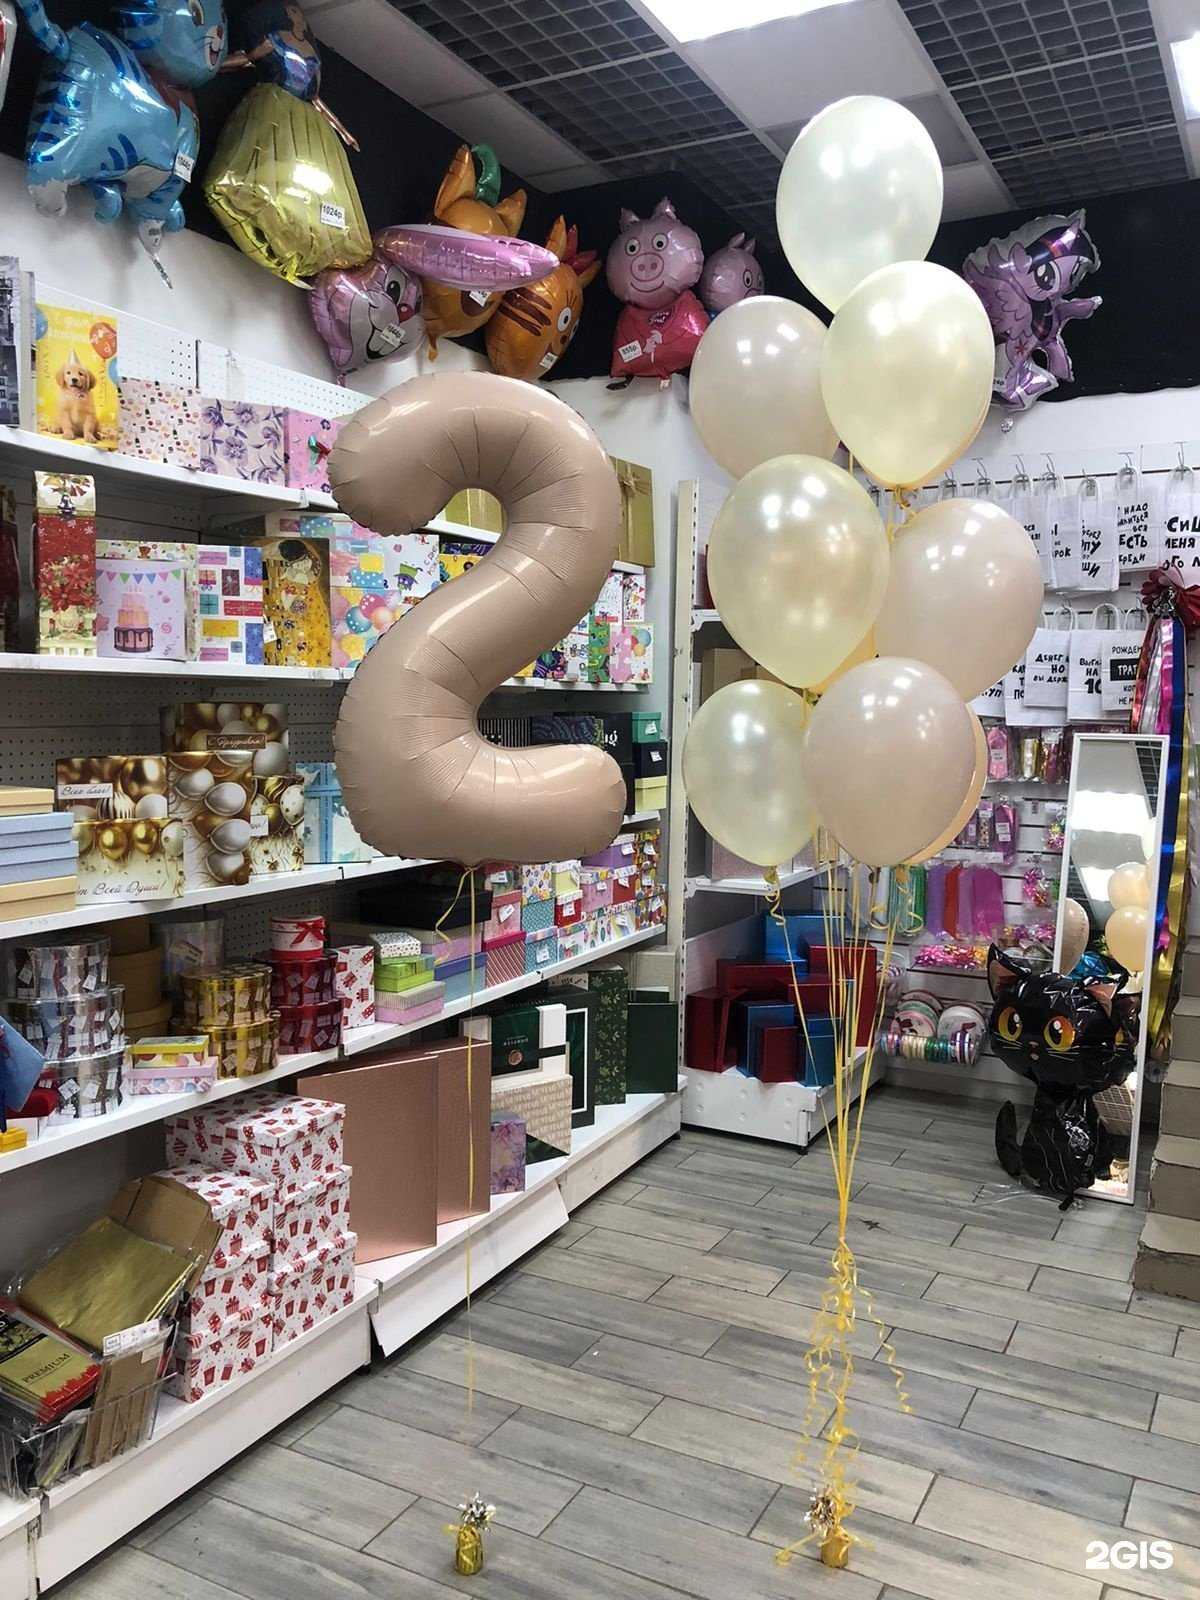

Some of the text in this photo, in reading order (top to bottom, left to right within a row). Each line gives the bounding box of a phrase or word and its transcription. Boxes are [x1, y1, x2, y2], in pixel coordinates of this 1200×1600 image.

[1124, 503, 1148, 515] НАДО
[1118, 553, 1146, 565] ЕРЕДИ
[1081, 562, 1101, 578] ШИ
[331, 371, 627, 865] 2
[1051, 664, 1066, 674] НО
[1086, 667, 1099, 677] НА
[93, 881, 121, 896] Всей
[126, 880, 167, 897] Души!
[22, 1353, 71, 1383] PREMIUM
